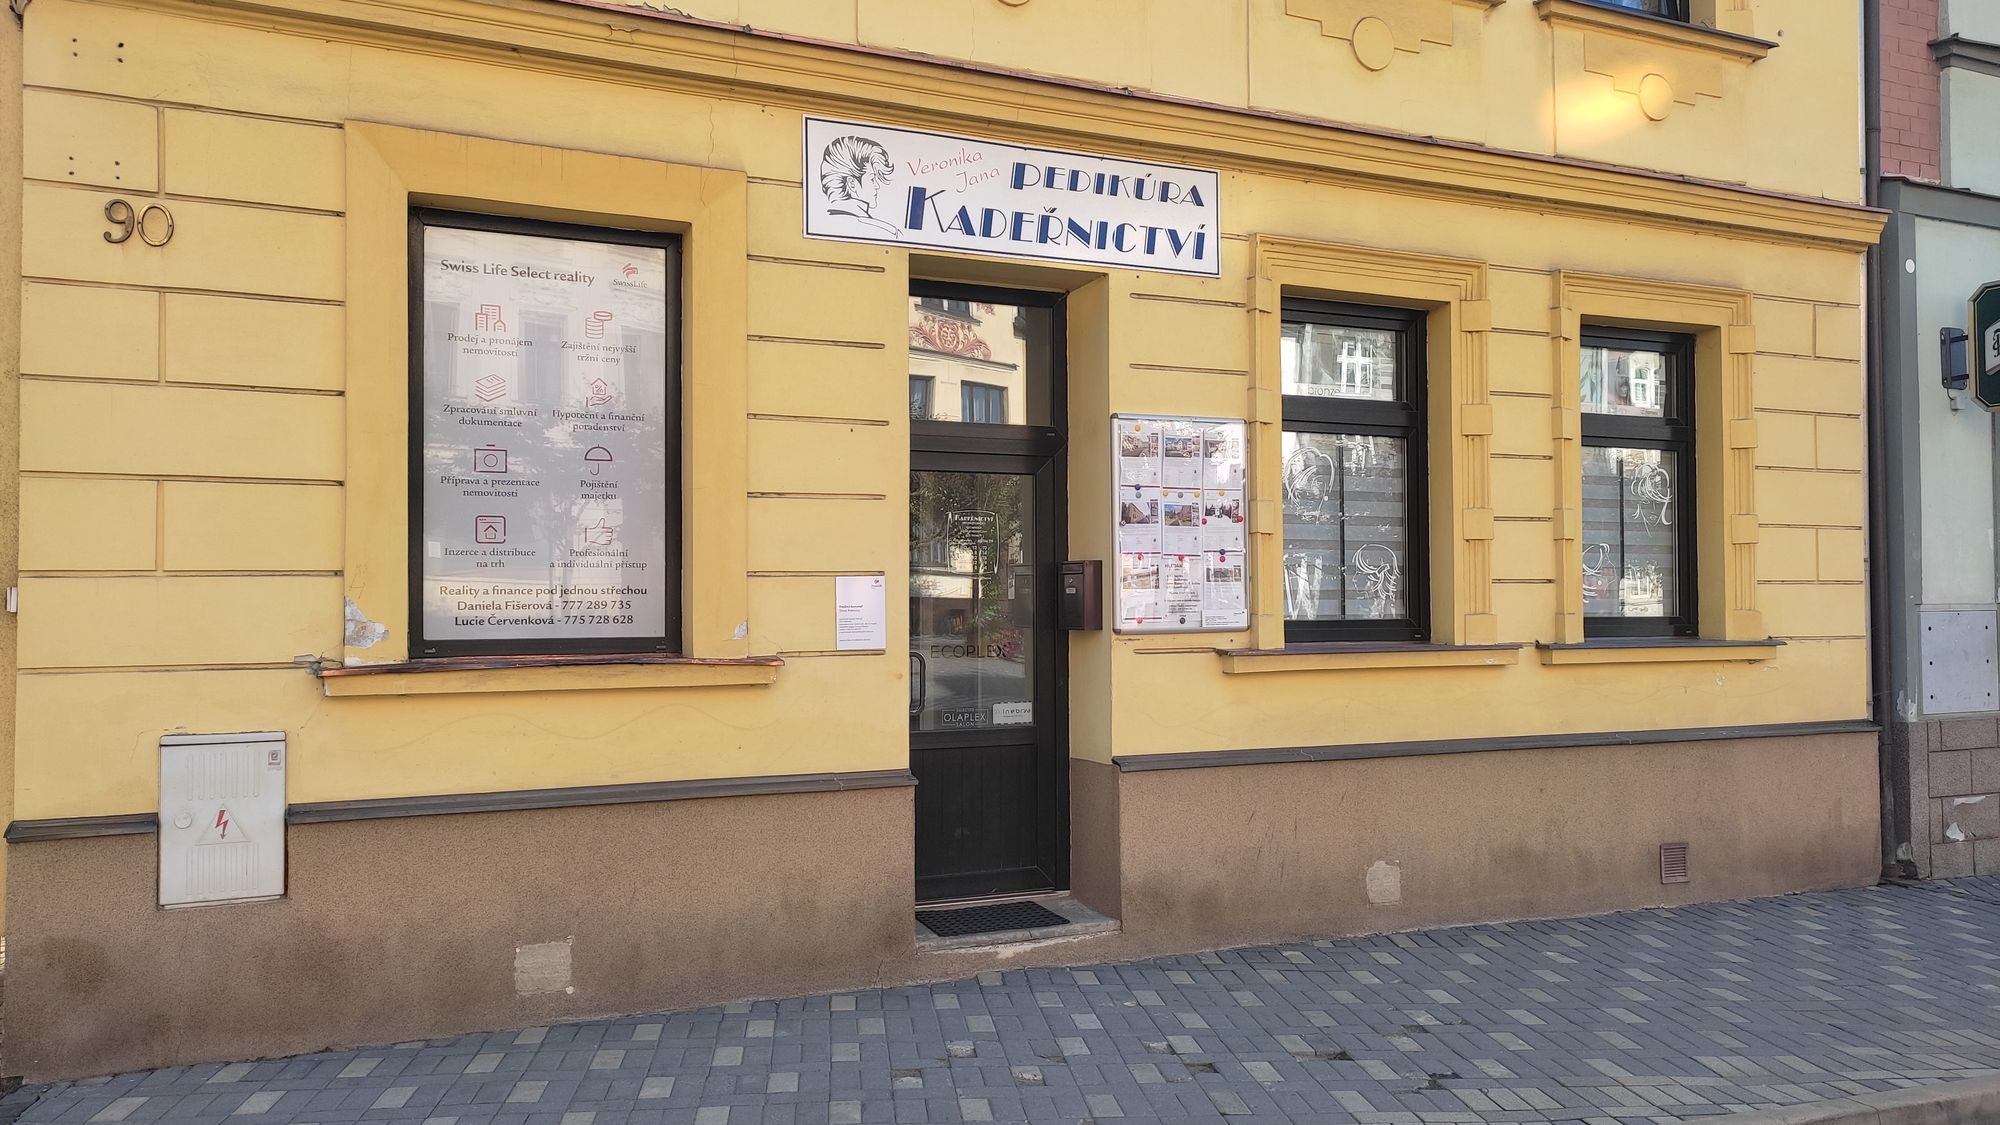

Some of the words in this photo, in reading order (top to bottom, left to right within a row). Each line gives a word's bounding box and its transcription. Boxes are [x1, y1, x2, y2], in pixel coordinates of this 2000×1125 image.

[906, 147, 983, 177] Veronika
[955, 167, 1001, 194] Jana
[1009, 161, 1206, 208] PEDIKÚRA
[104, 199, 174, 246] 90
[905, 185, 1207, 260] KADEŘNICTVÍ
[440, 259, 479, 273] Swiss
[483, 263, 508, 276] Life
[511, 266, 550, 280] Select
[554, 271, 595, 287] reality
[447, 332, 479, 346] Prodej
[488, 337, 533, 347] pronájem
[561, 340, 600, 353] Zajištění
[603, 343, 636, 354] nejvyšší
[578, 354, 598, 363] tržní
[601, 357, 621, 365] ceny
[443, 404, 497, 415] Zpracování
[499, 406, 538, 416] smluvní
[552, 409, 599, 422] Hypoteční
[608, 412, 645, 422] finanční
[459, 417, 523, 428] dokumentace
[573, 423, 626, 433] poradenství
[440, 475, 480, 486] Příprava
[491, 479, 540, 487] prezentace
[580, 479, 618, 491] Pojištění
[581, 491, 617, 501] majetku
[444, 548, 479, 556] Inzerce
[489, 547, 536, 557] distribuce
[569, 548, 629, 558] Profesionální
[490, 559, 505, 568] trh
[557, 559, 613, 569] individuální
[615, 560, 648, 571] přístup
[439, 586, 480, 598] Reality
[492, 585, 533, 596] finance
[536, 585, 557, 598] pod
[559, 585, 598, 598] jednou
[600, 585, 648, 596] střechou
[457, 600, 502, 612] Daniela
[505, 599, 553, 611] Fišerová
[562, 600, 582, 610] 777
[586, 600, 607, 610] 289
[610, 600, 631, 610] 735
[455, 616, 485, 627] Lucie
[487, 613, 555, 626] Červenková
[564, 615, 586, 626] 775
[589, 615, 610, 625] 728
[612, 615, 634, 625] 628
[930, 645, 1007, 658] ECOPLEX
[943, 713, 986, 722] OLAPLEX
